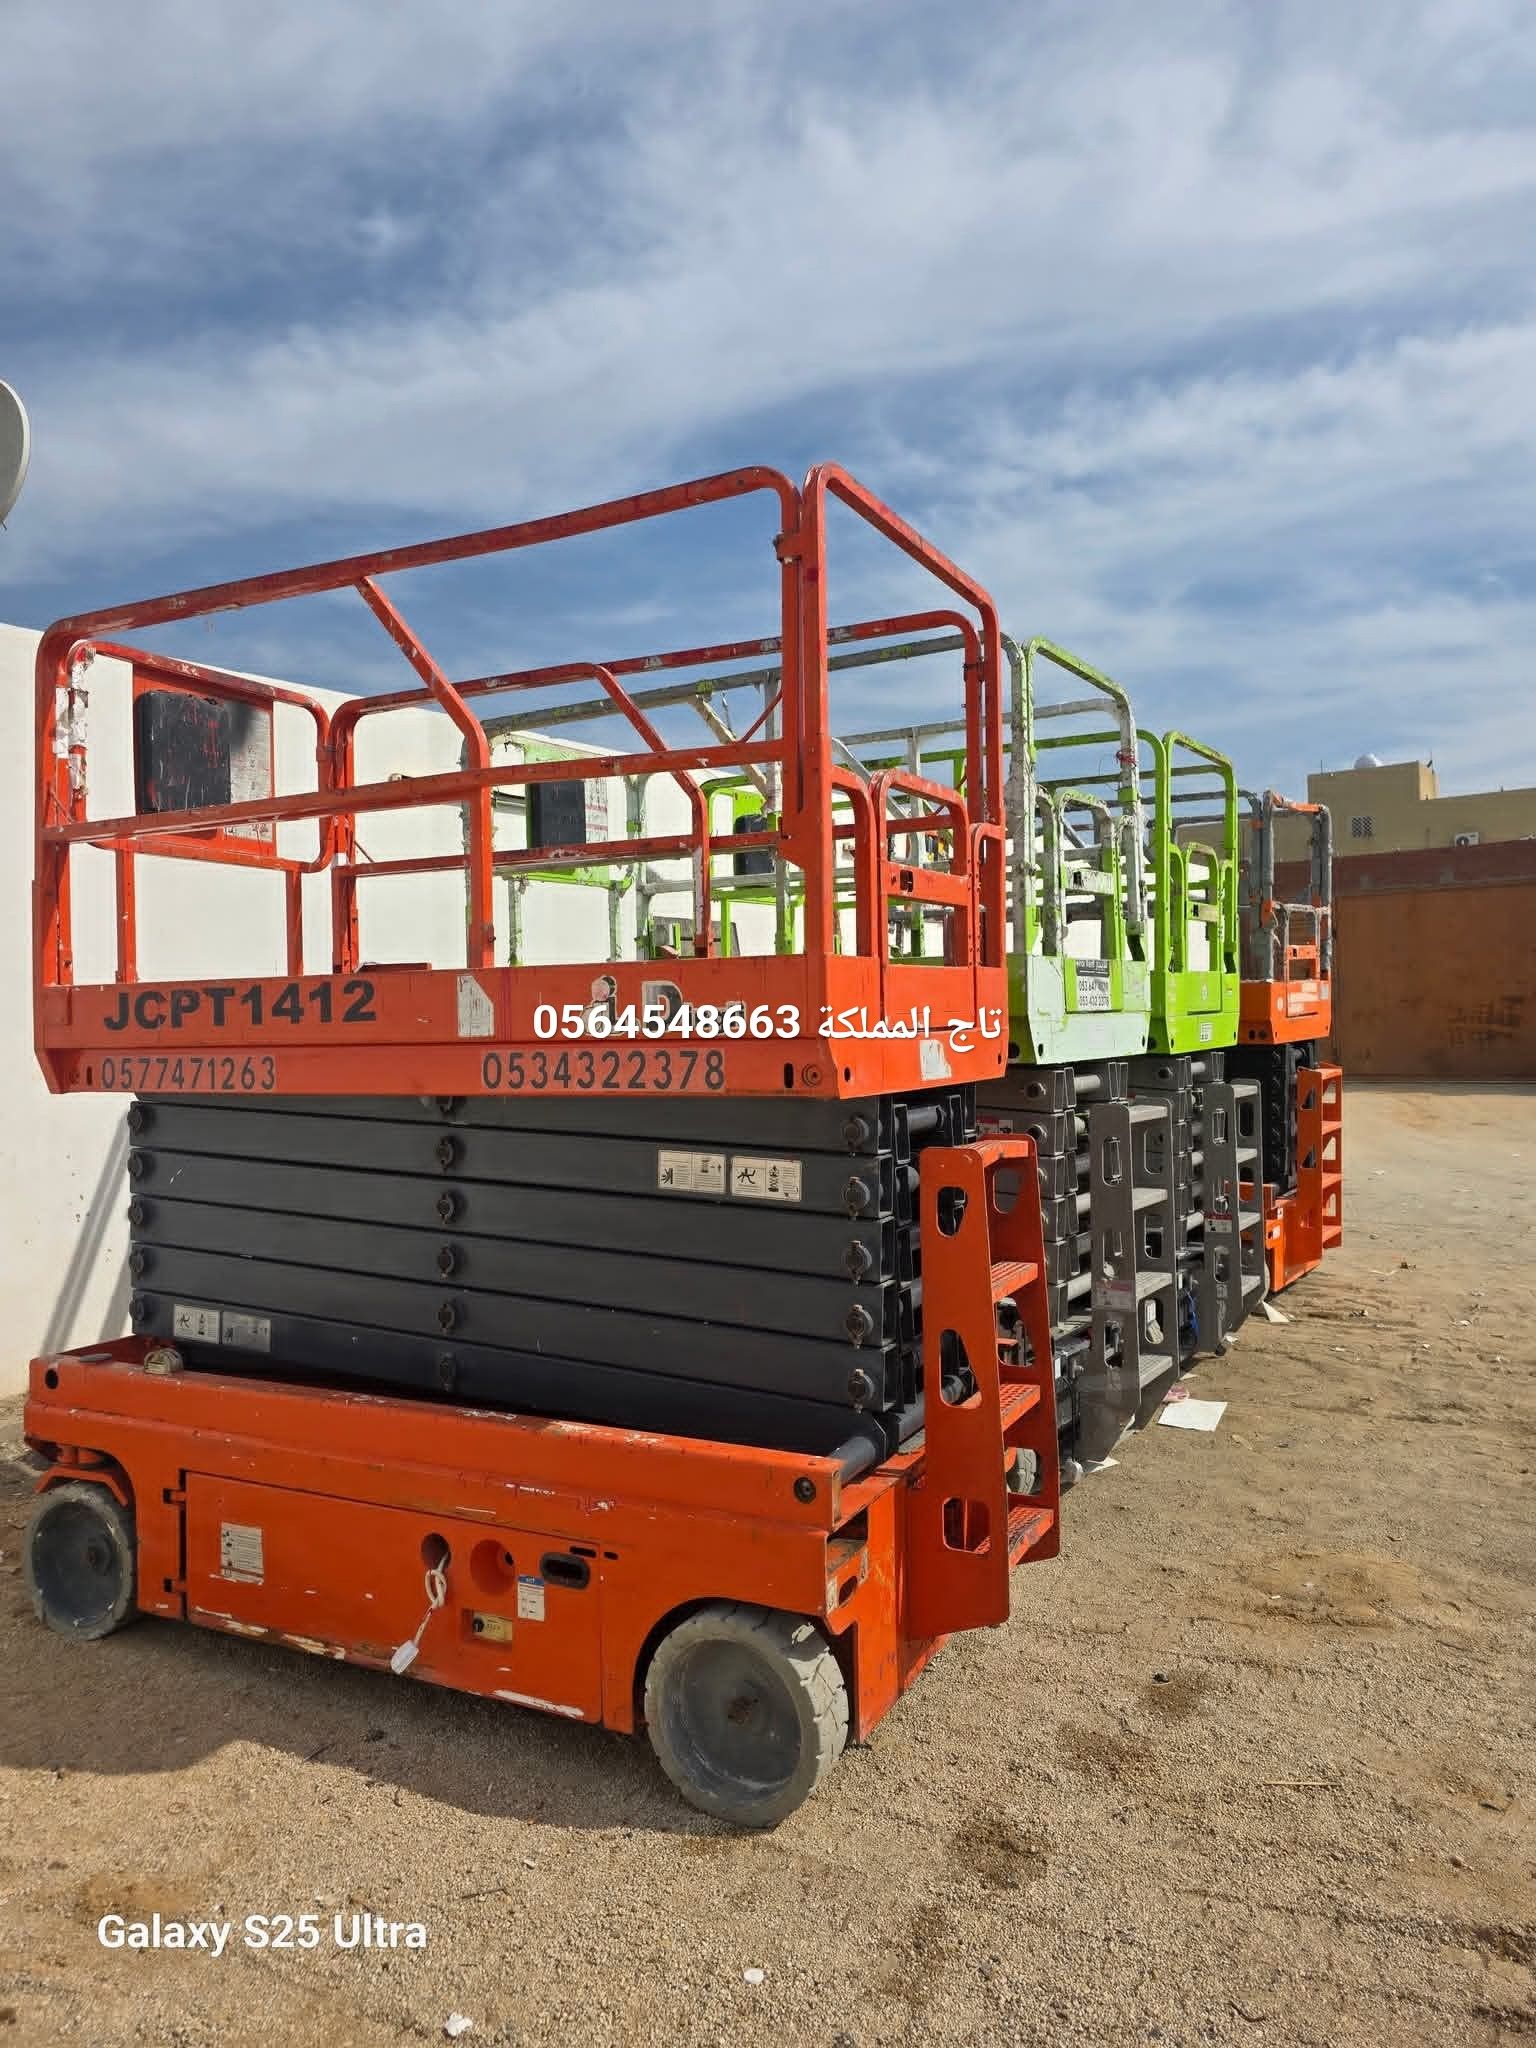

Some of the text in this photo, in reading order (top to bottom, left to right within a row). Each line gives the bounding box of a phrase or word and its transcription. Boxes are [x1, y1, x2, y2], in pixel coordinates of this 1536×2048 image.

[103, 980, 377, 1031] JCPT1412
[101, 1056, 276, 1090] 0577471263
[482, 1050, 725, 1090] 0534322378
